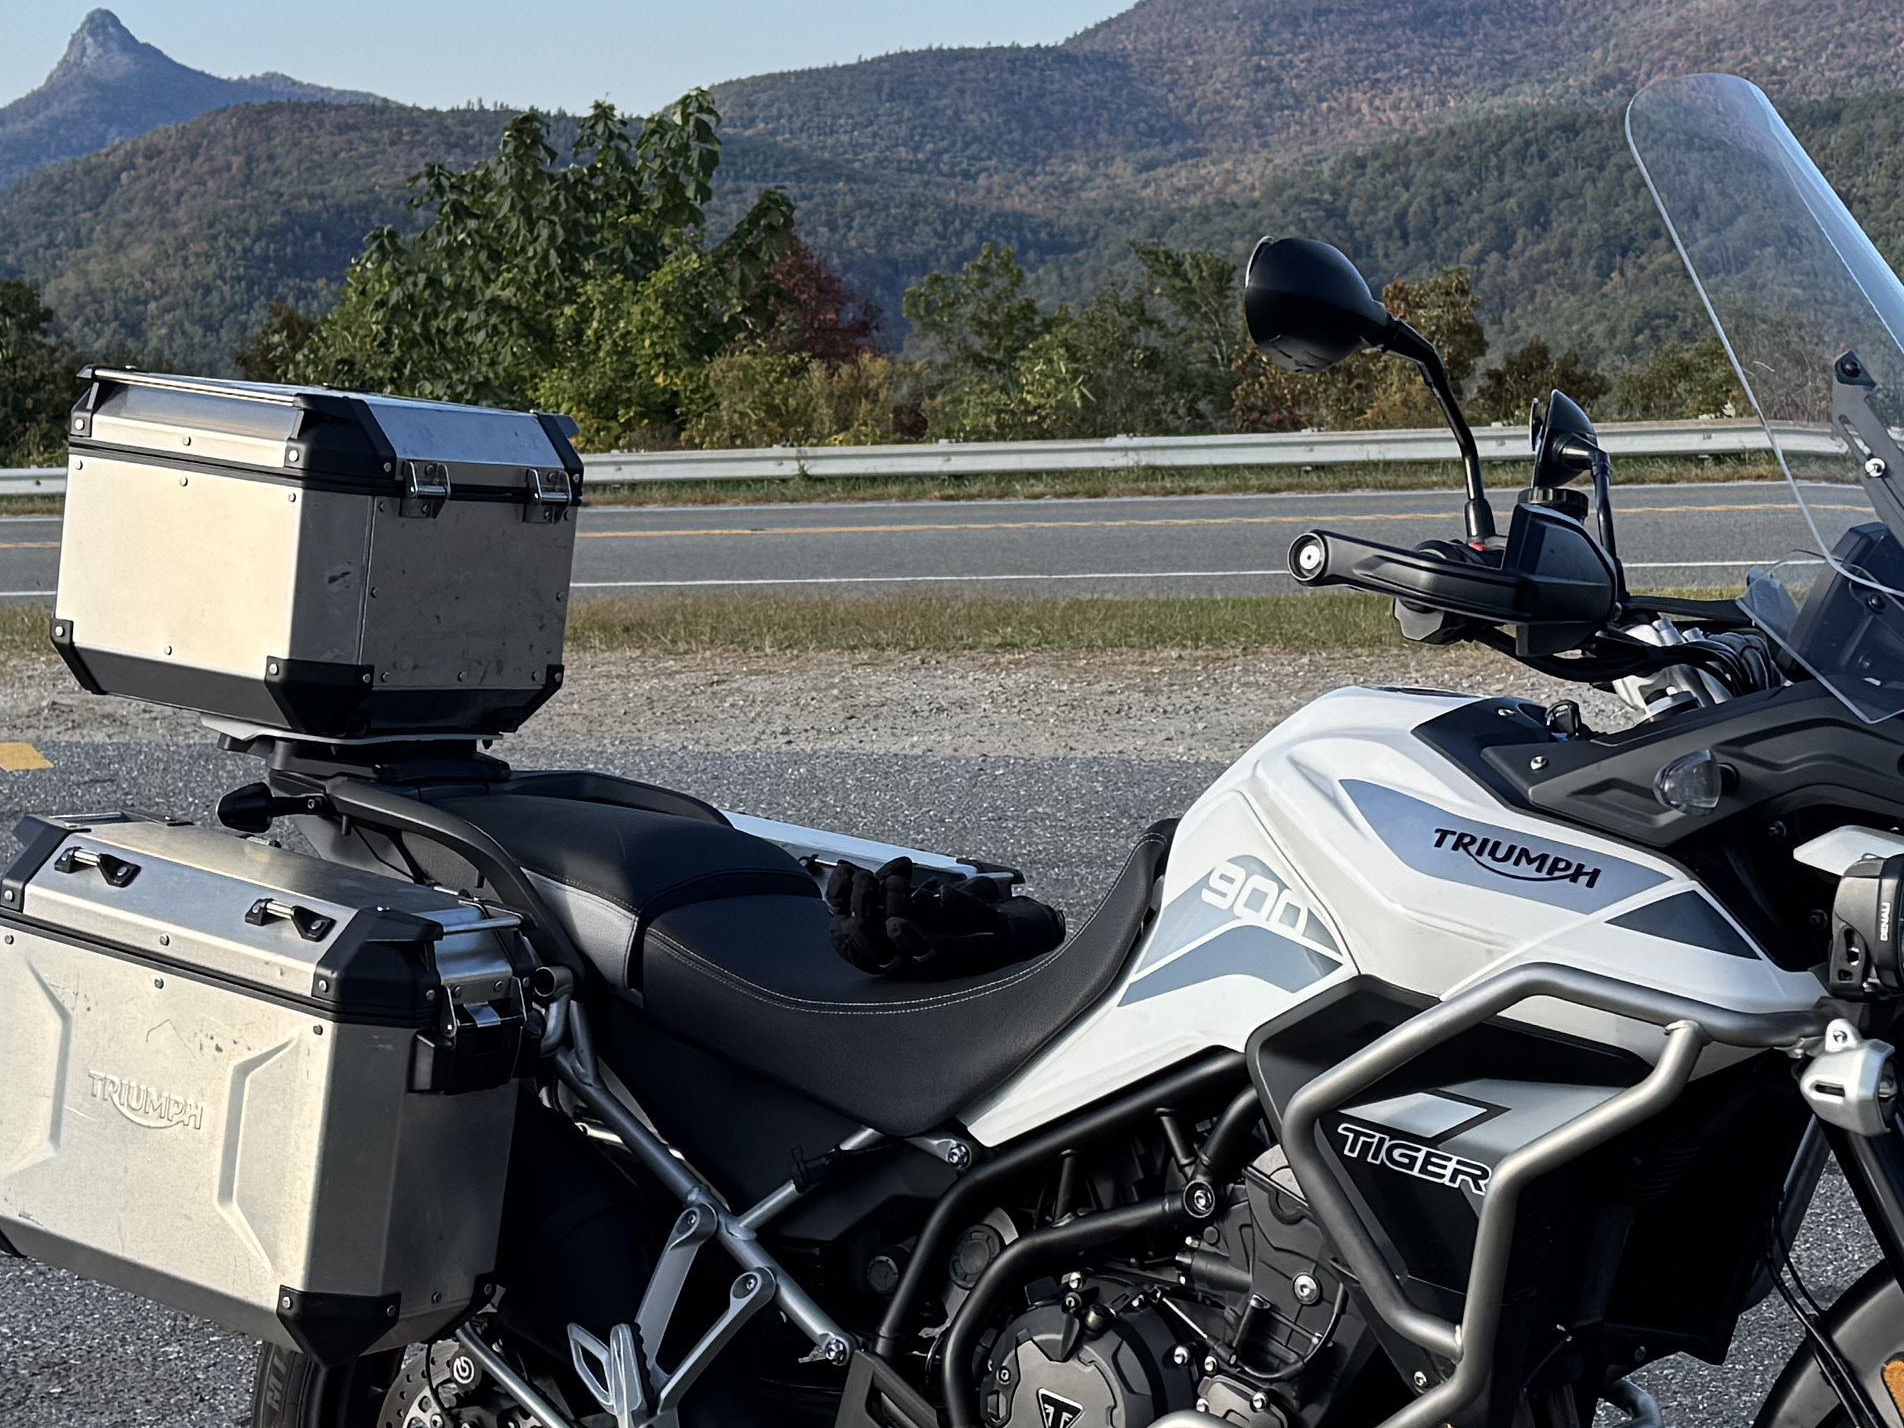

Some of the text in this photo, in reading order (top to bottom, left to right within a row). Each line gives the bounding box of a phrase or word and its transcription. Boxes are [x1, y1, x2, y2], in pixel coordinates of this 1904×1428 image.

[1433, 827, 1602, 890] TRIUMPH
[1200, 861, 1309, 937] 900
[1879, 901, 1891, 942] DENALI
[87, 1069, 206, 1131] TRIUMPH
[1337, 1123, 1493, 1197] TIGER
